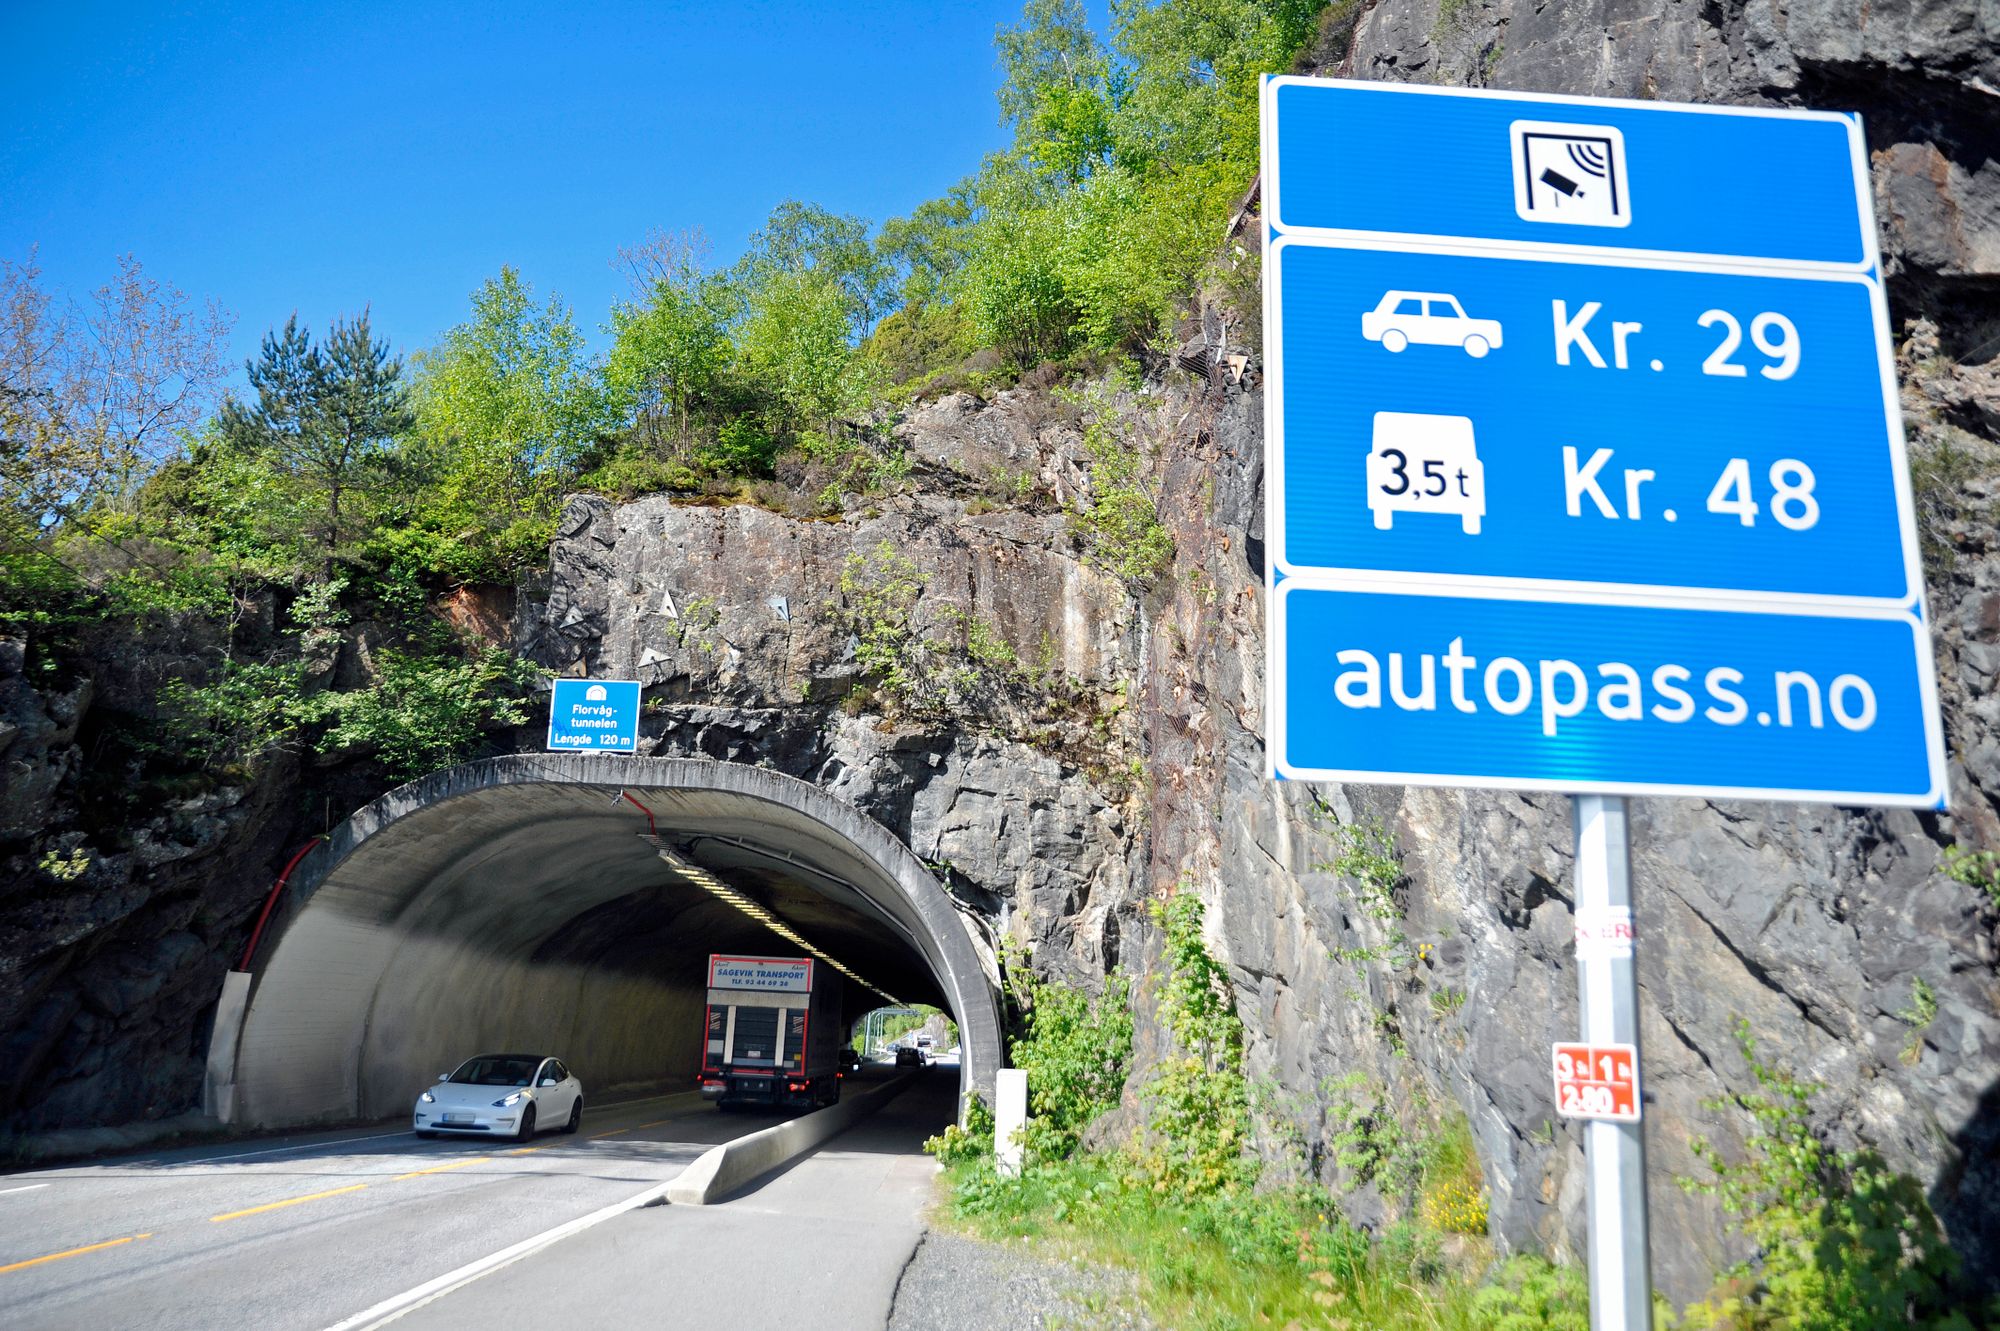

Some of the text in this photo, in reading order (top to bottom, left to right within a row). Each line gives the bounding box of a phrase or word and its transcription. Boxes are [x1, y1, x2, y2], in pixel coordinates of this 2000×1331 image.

[1552, 299, 1801, 381] Kr. 29
[1380, 448, 1470, 500] 3,5 t
[1562, 445, 1820, 531] Kr. 48
[1333, 636, 1877, 736] autopass.no
[554, 733, 630, 746] Lengde 120 m
[571, 718, 617, 728] tunnelen
[756, 970, 804, 979] TRANSPORT
